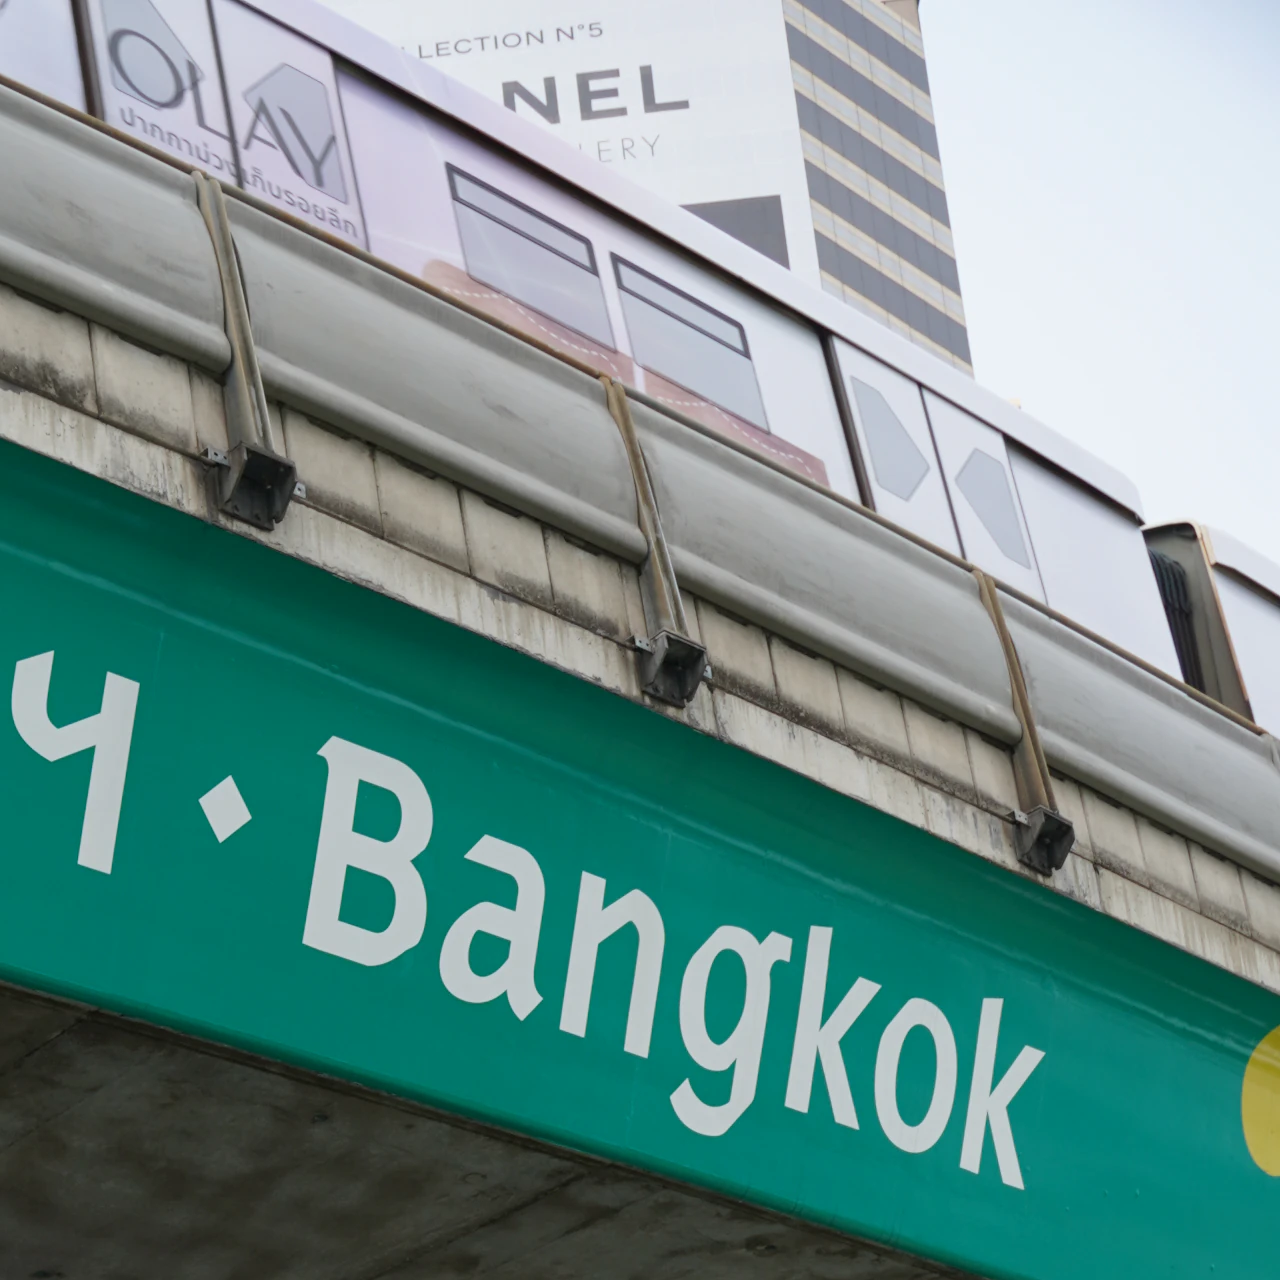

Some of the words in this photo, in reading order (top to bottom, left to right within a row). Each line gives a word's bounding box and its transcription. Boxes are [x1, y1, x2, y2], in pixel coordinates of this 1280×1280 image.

[401, 29, 545, 59] LECTION
[108, 27, 337, 188] OLAY
[578, 133, 661, 164] ERY
[301, 734, 1047, 1190] Bangkok
